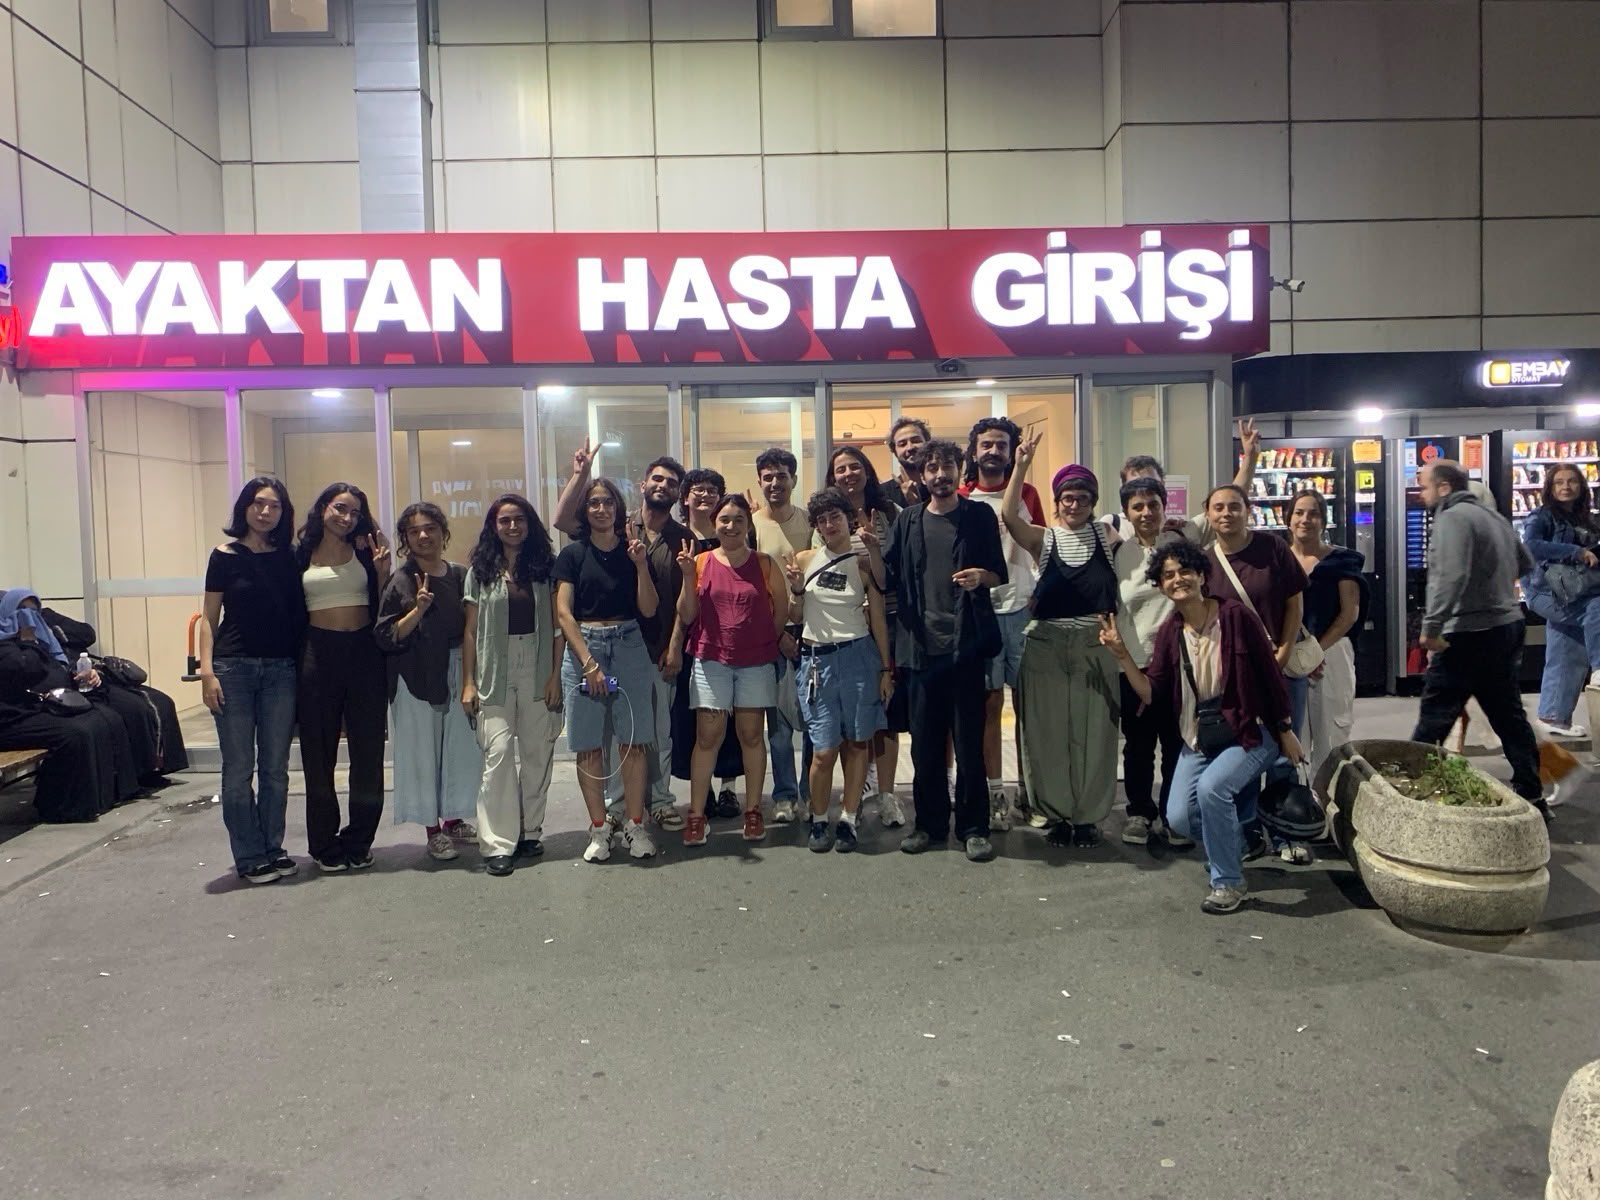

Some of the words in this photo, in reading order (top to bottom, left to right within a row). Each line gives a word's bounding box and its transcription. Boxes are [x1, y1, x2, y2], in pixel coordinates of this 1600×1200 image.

[28, 257, 504, 338] AYAKTAN
[577, 255, 916, 332] HASTA
[972, 229, 1255, 340] GİRİŞİ
